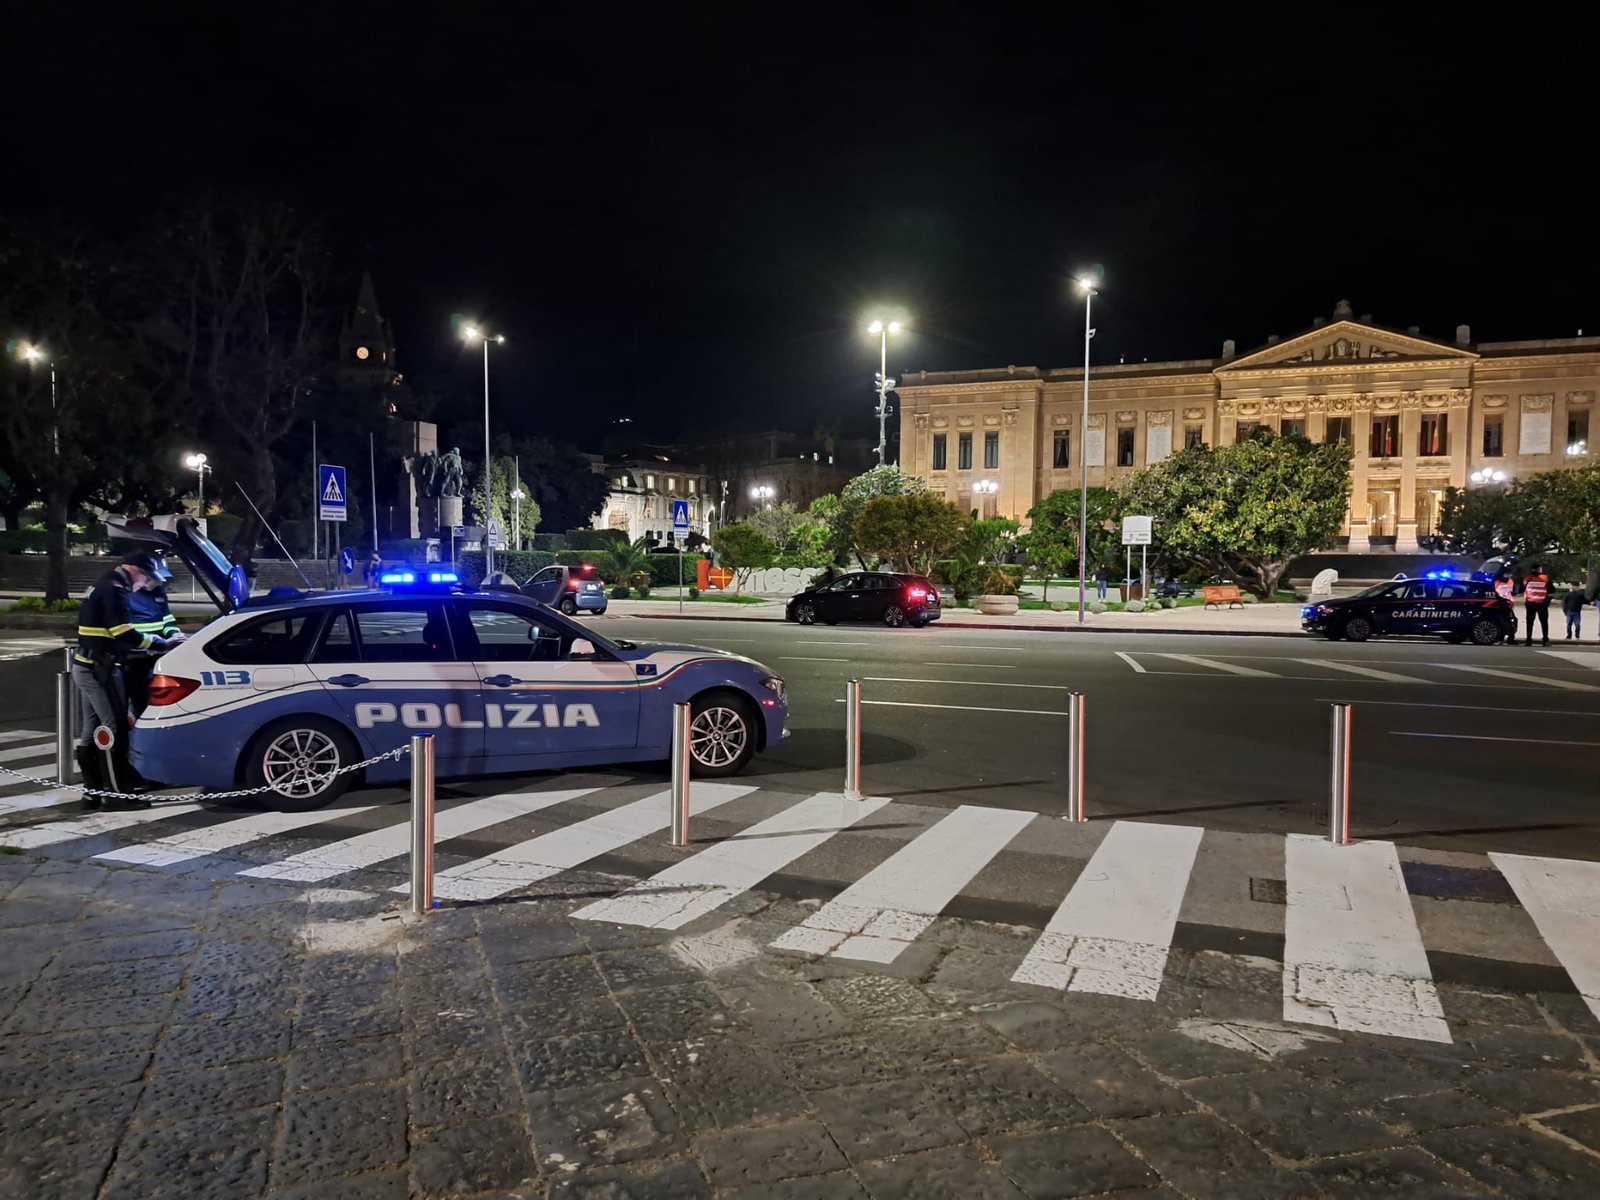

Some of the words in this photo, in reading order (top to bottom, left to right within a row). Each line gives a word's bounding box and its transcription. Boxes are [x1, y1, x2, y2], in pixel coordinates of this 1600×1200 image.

[1392, 610, 1462, 618] CARABINIERI
[200, 670, 251, 686] 113
[354, 702, 600, 729] POLIZIA
